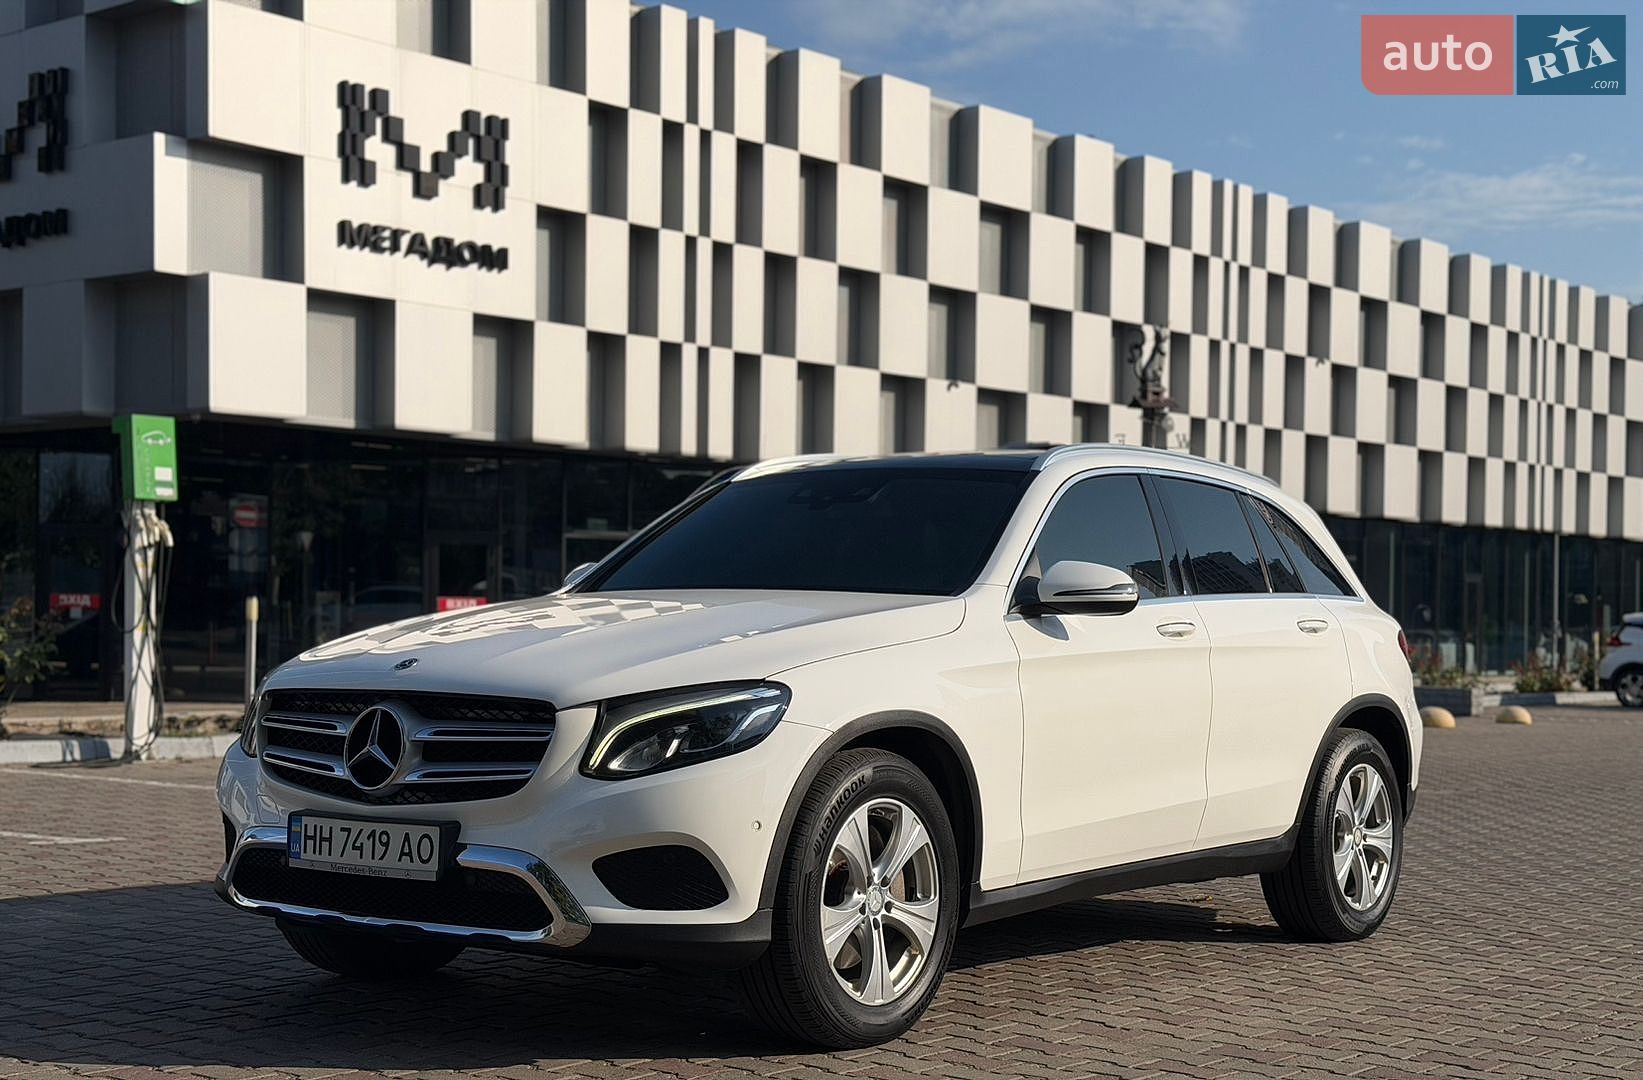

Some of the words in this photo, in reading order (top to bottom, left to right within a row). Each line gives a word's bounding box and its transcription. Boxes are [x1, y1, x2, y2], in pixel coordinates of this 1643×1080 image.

[337, 220, 508, 273] МЕГАДОМ
[290, 842, 300, 852] UA
[303, 824, 333, 857] HH
[339, 827, 391, 861] 7419
[398, 831, 434, 865] AO
